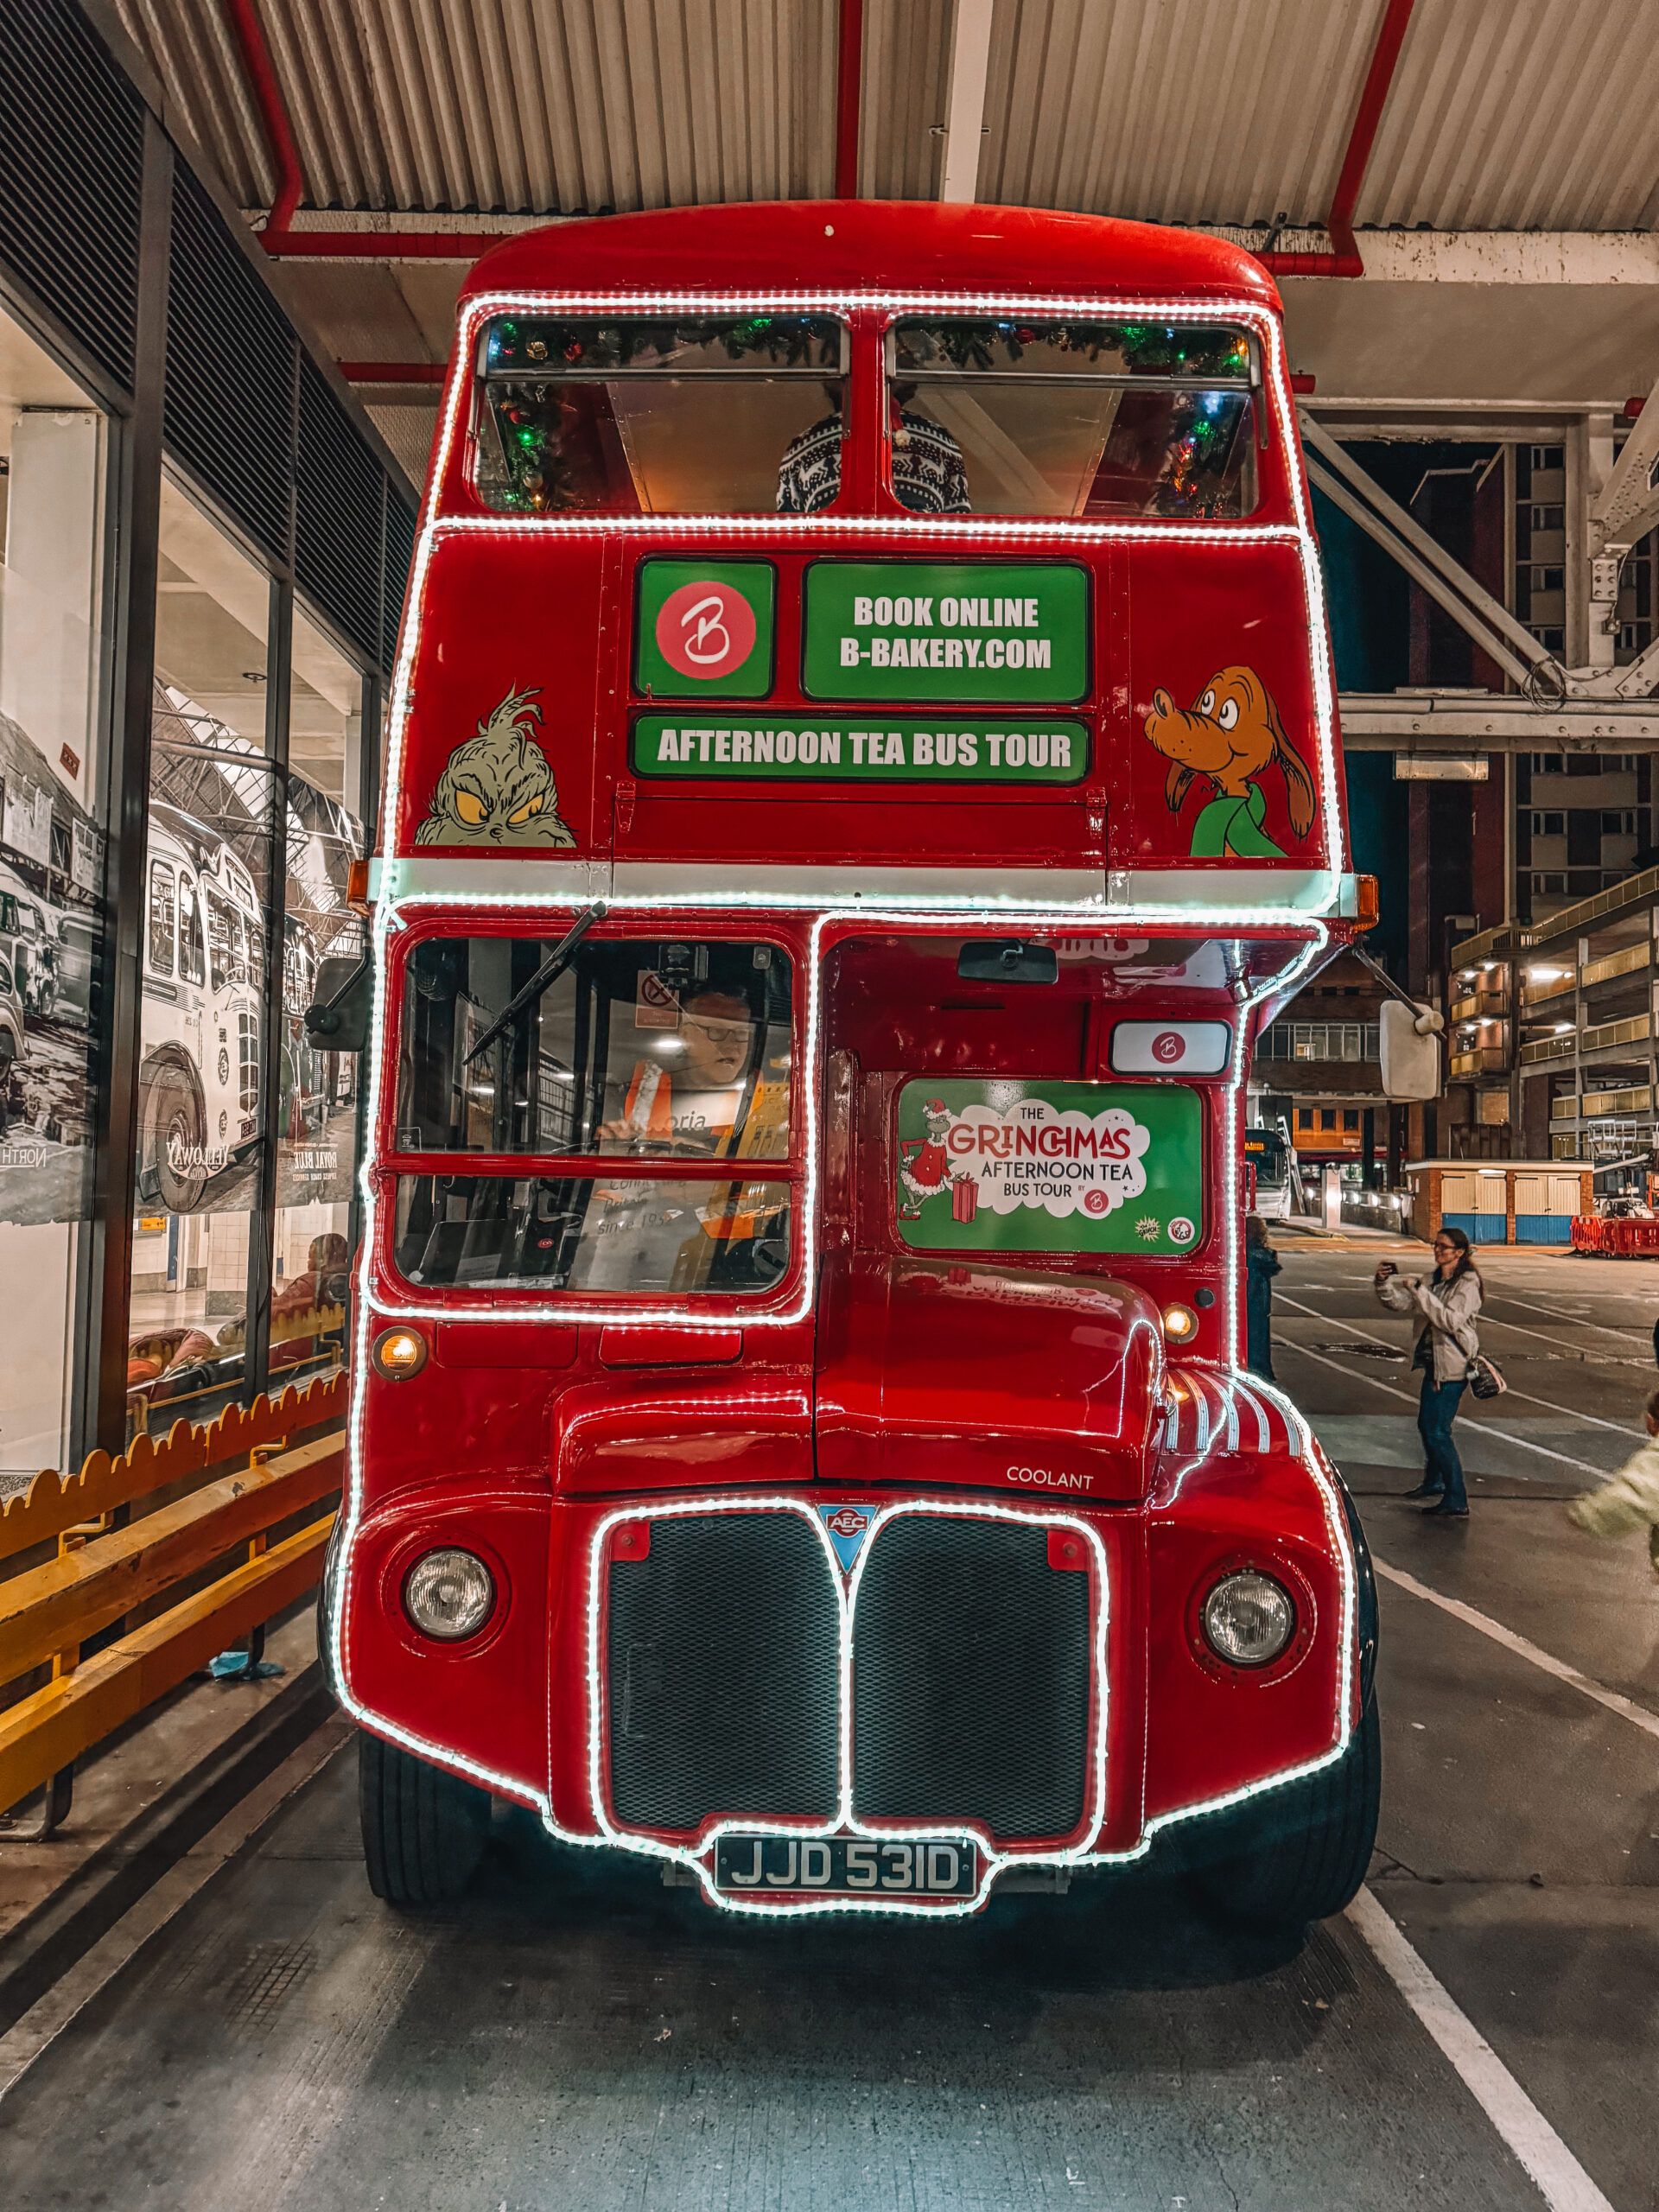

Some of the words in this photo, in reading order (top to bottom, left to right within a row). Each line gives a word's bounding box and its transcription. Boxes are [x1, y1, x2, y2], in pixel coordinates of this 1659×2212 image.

[854, 596, 935, 626] BOOK
[939, 597, 1039, 627] ONLINE
[680, 595, 730, 664] B
[840, 639, 1052, 669] B-BAKERY.COM
[657, 728, 842, 765] AFTERNOON
[849, 732, 906, 766] TEA
[912, 733, 980, 766] BUS
[985, 734, 1071, 767] TOUR
[1020, 1107, 1045, 1120] THE
[947, 1123, 1131, 1160] GRINCHMAS
[981, 1160, 1095, 1181] AFTERNOON
[1099, 1163, 1133, 1181] TEA
[1003, 1183, 1029, 1197] BUS
[1033, 1183, 1071, 1198] TOUR
[1006, 1465, 1094, 1491] COOLANT
[830, 1516, 866, 1529] AEC
[730, 1840, 832, 1886] JJD
[845, 1842, 960, 1891] 531D
